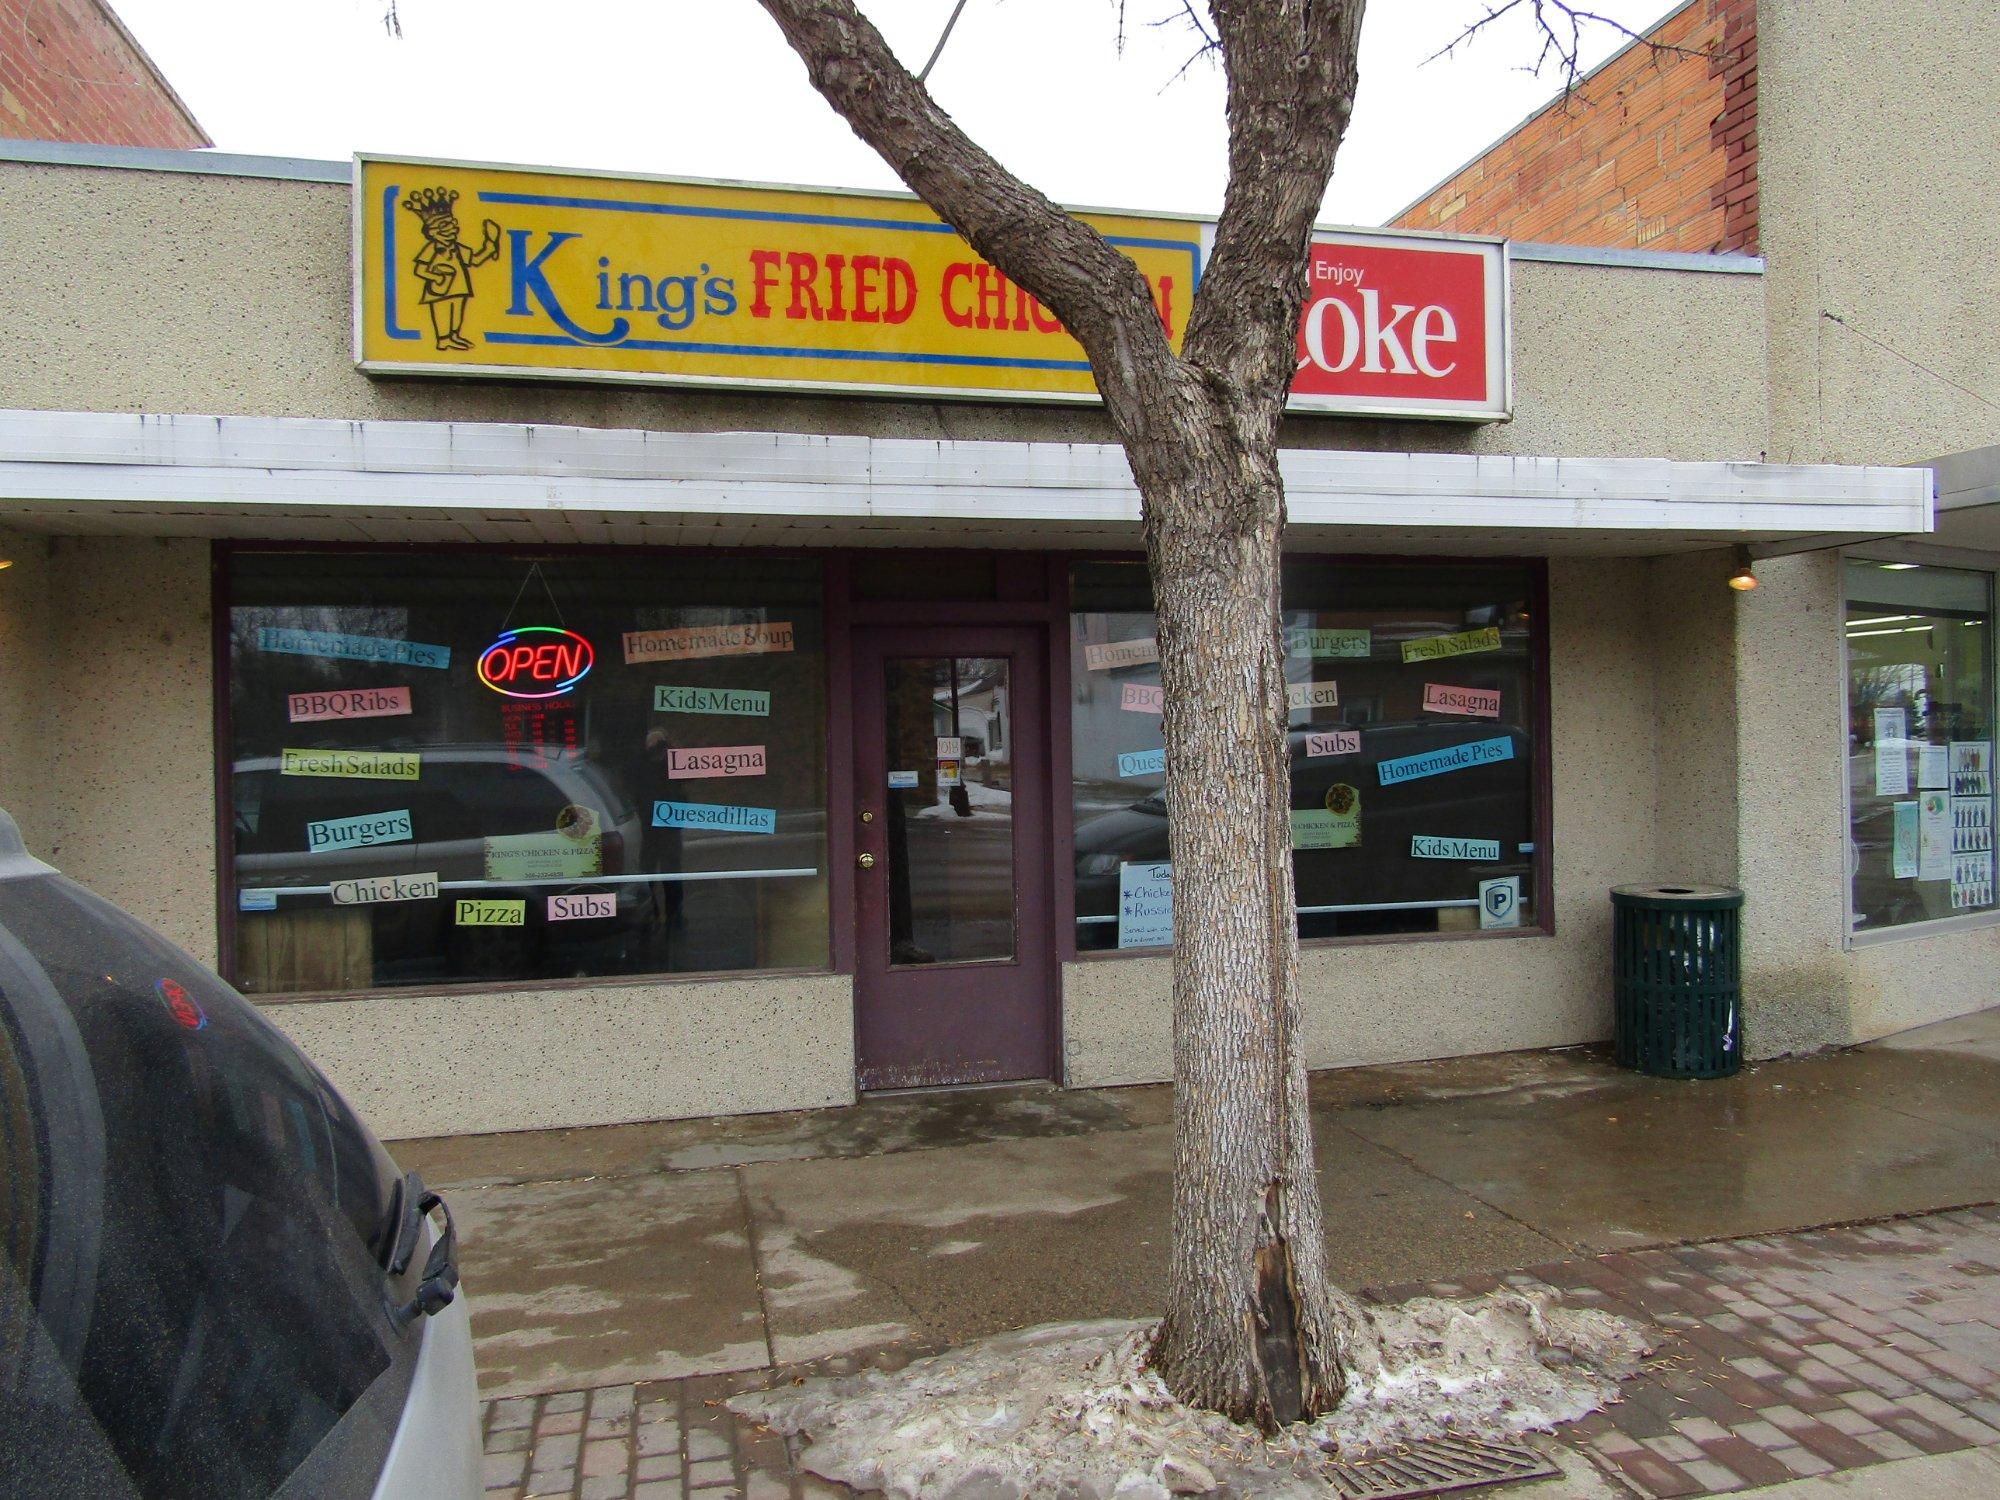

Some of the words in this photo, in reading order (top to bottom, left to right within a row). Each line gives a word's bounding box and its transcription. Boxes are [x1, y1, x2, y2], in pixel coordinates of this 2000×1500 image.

[1315, 260, 1365, 287] Enjoy
[505, 229, 737, 344] King's
[749, 249, 918, 325] FRIED
[940, 262, 1173, 340] CHIN
[1297, 288, 1457, 378] oke
[394, 642, 437, 664] Pies
[627, 629, 741, 654] Homemade
[744, 627, 793, 646] Soup
[1293, 630, 1368, 655] Burgers
[1403, 638, 1446, 661] Fresh
[1449, 631, 1500, 653] Salads
[483, 643, 583, 682] OPEN
[1089, 643, 1158, 665] Homem
[292, 693, 348, 716] BBQ
[350, 691, 400, 713] Ribs
[658, 688, 706, 710] Kids
[708, 692, 766, 713] Menu
[1291, 685, 1336, 705] cken
[1425, 684, 1499, 713] Lasagna
[1310, 734, 1356, 755] Subs
[283, 751, 343, 774] Fresh
[345, 753, 417, 776] Salads
[669, 750, 765, 774] Lasagna
[1380, 751, 1470, 781] Homemade
[1471, 742, 1504, 763] Pies
[655, 802, 769, 828] Quesadillas
[308, 815, 410, 846] Burgers
[521, 848, 561, 858] CHICKEN
[571, 846, 596, 856] PIZZA
[1411, 838, 1450, 857] Kids
[1451, 841, 1498, 859] Menu
[333, 878, 438, 903] Chicken
[1134, 886, 1172, 899] Chicke
[458, 901, 523, 924] Pizza
[553, 895, 612, 919] Subs
[1134, 902, 1173, 917] Russi
